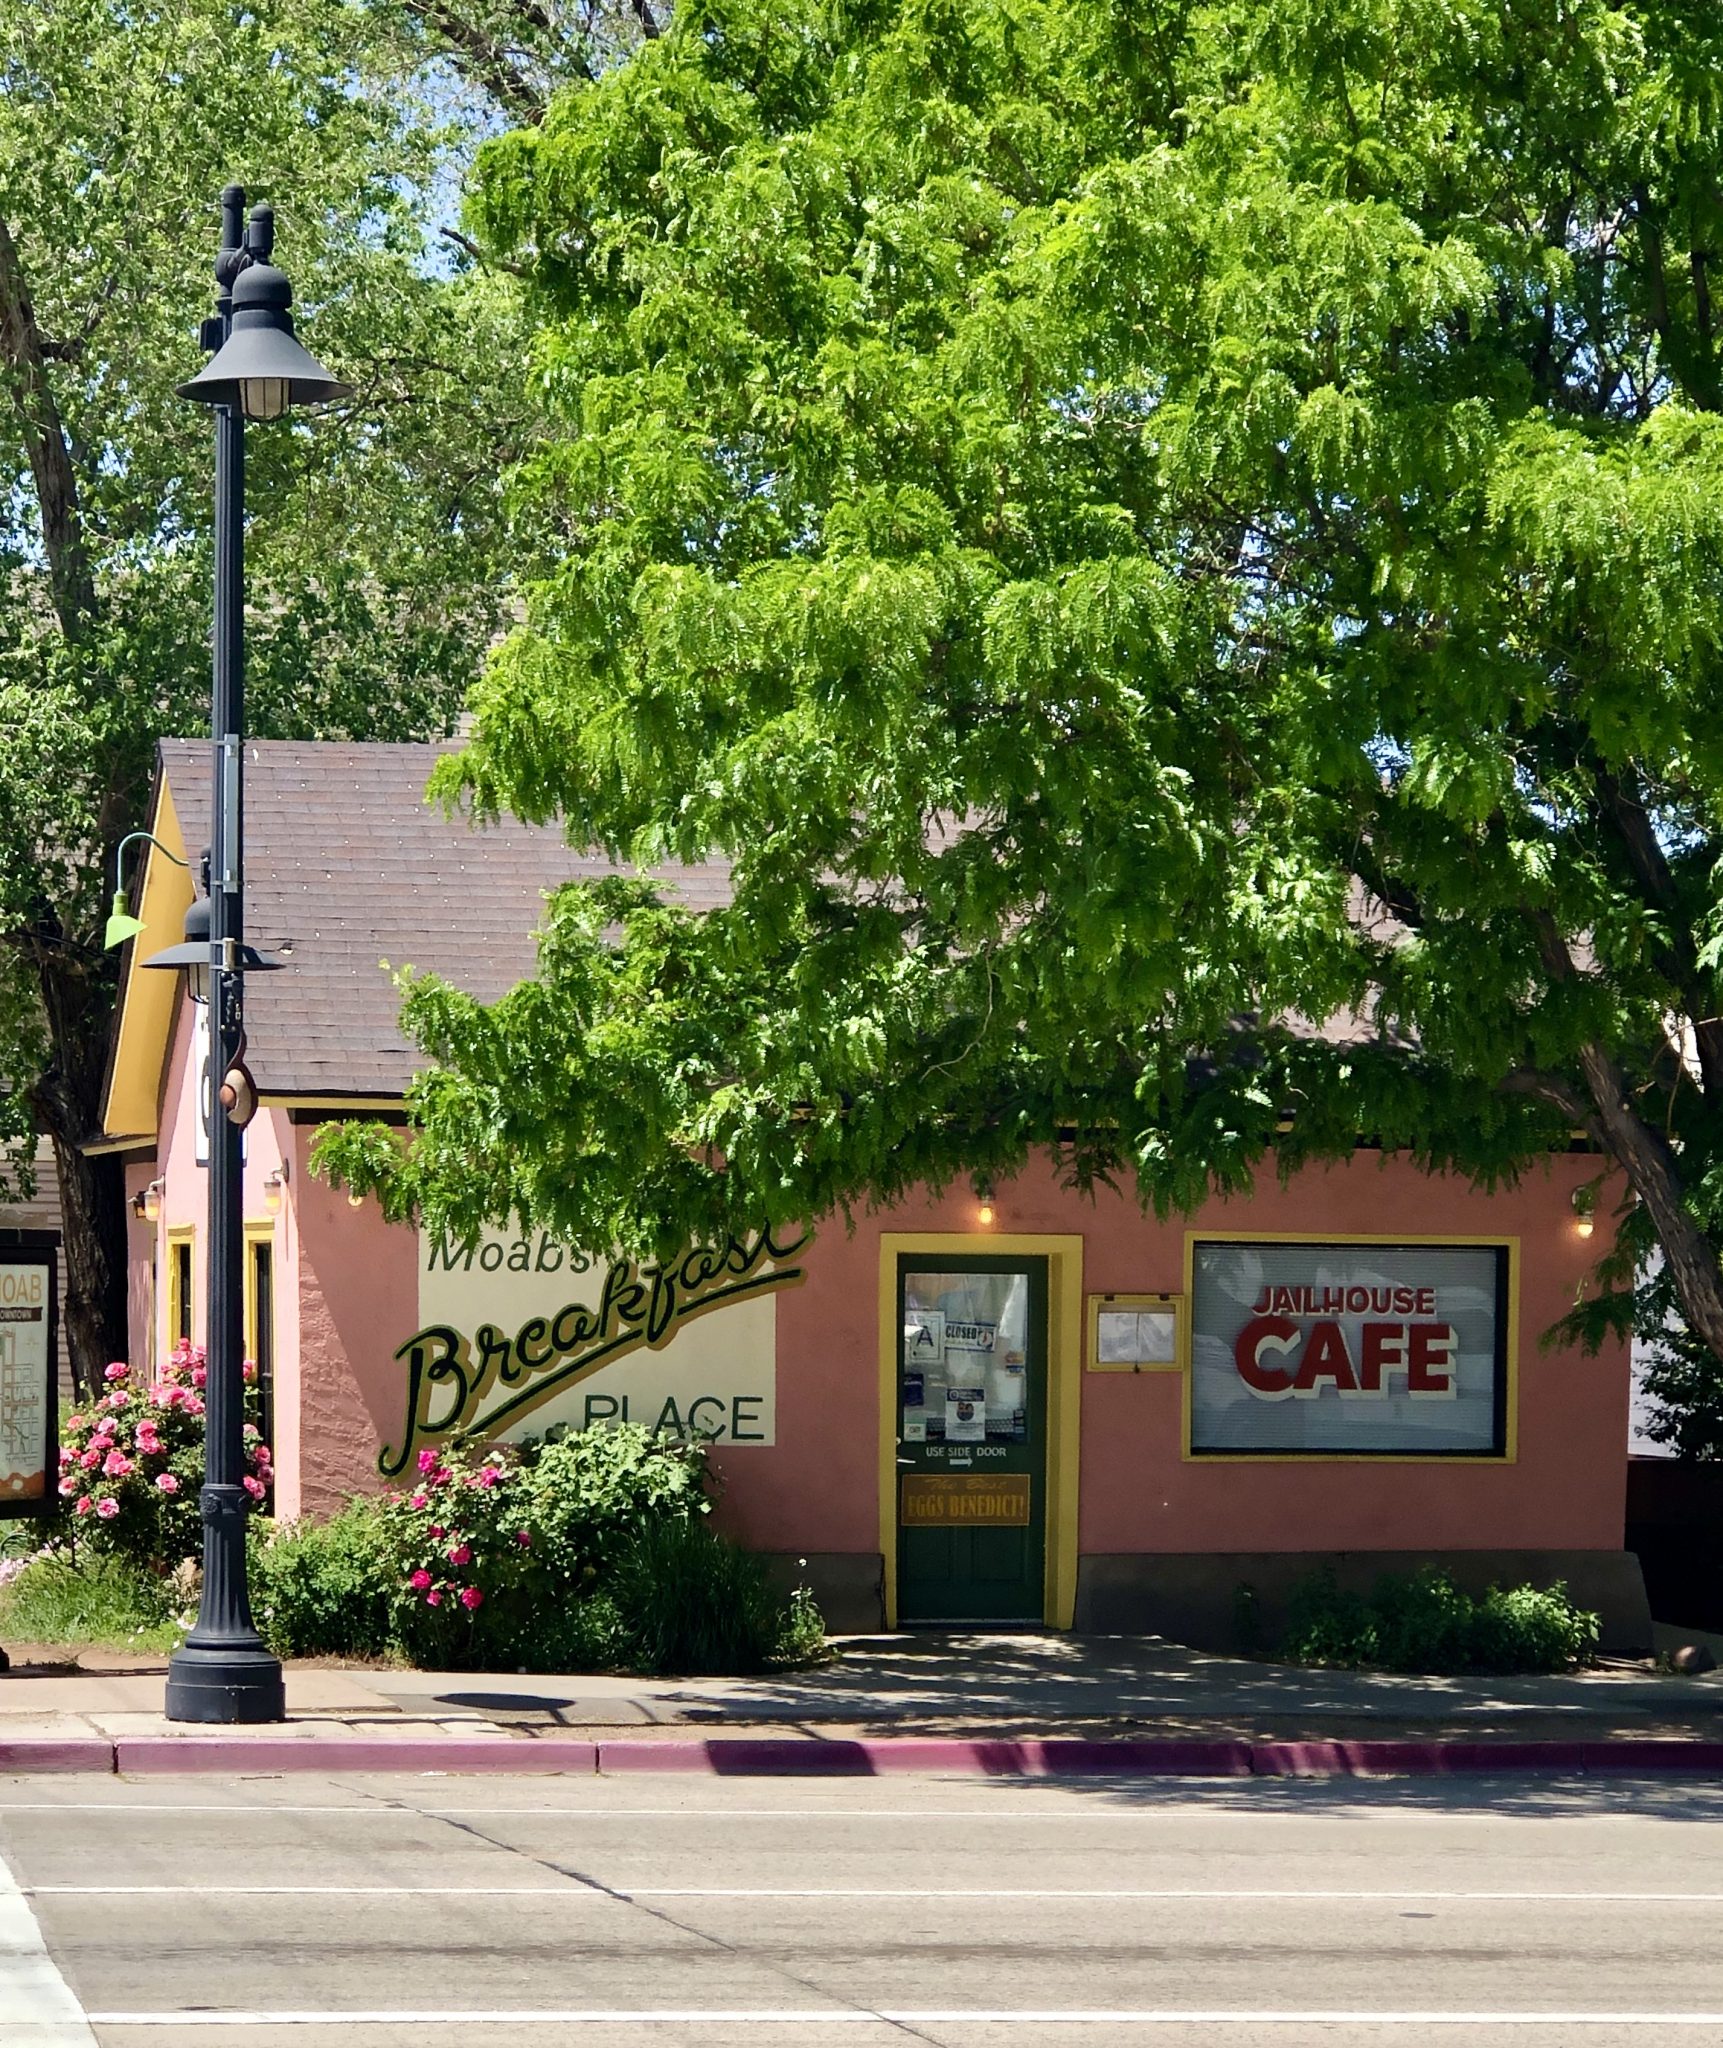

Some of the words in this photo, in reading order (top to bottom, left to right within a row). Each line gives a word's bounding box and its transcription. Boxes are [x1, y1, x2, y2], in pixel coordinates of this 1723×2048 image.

[0, 1273, 42, 1303] OAB
[1252, 1285, 1437, 1317] JAILHOUSE
[916, 1325, 934, 1347] A
[945, 1325, 977, 1340] CLOSED
[1234, 1316, 1459, 1401] CAFE
[926, 1447, 945, 1457] USE
[947, 1447, 971, 1457] SIDE
[976, 1447, 1007, 1457] DOOR
[907, 1495, 945, 1517] EGGS
[949, 1495, 1025, 1518] BENEDICT!
